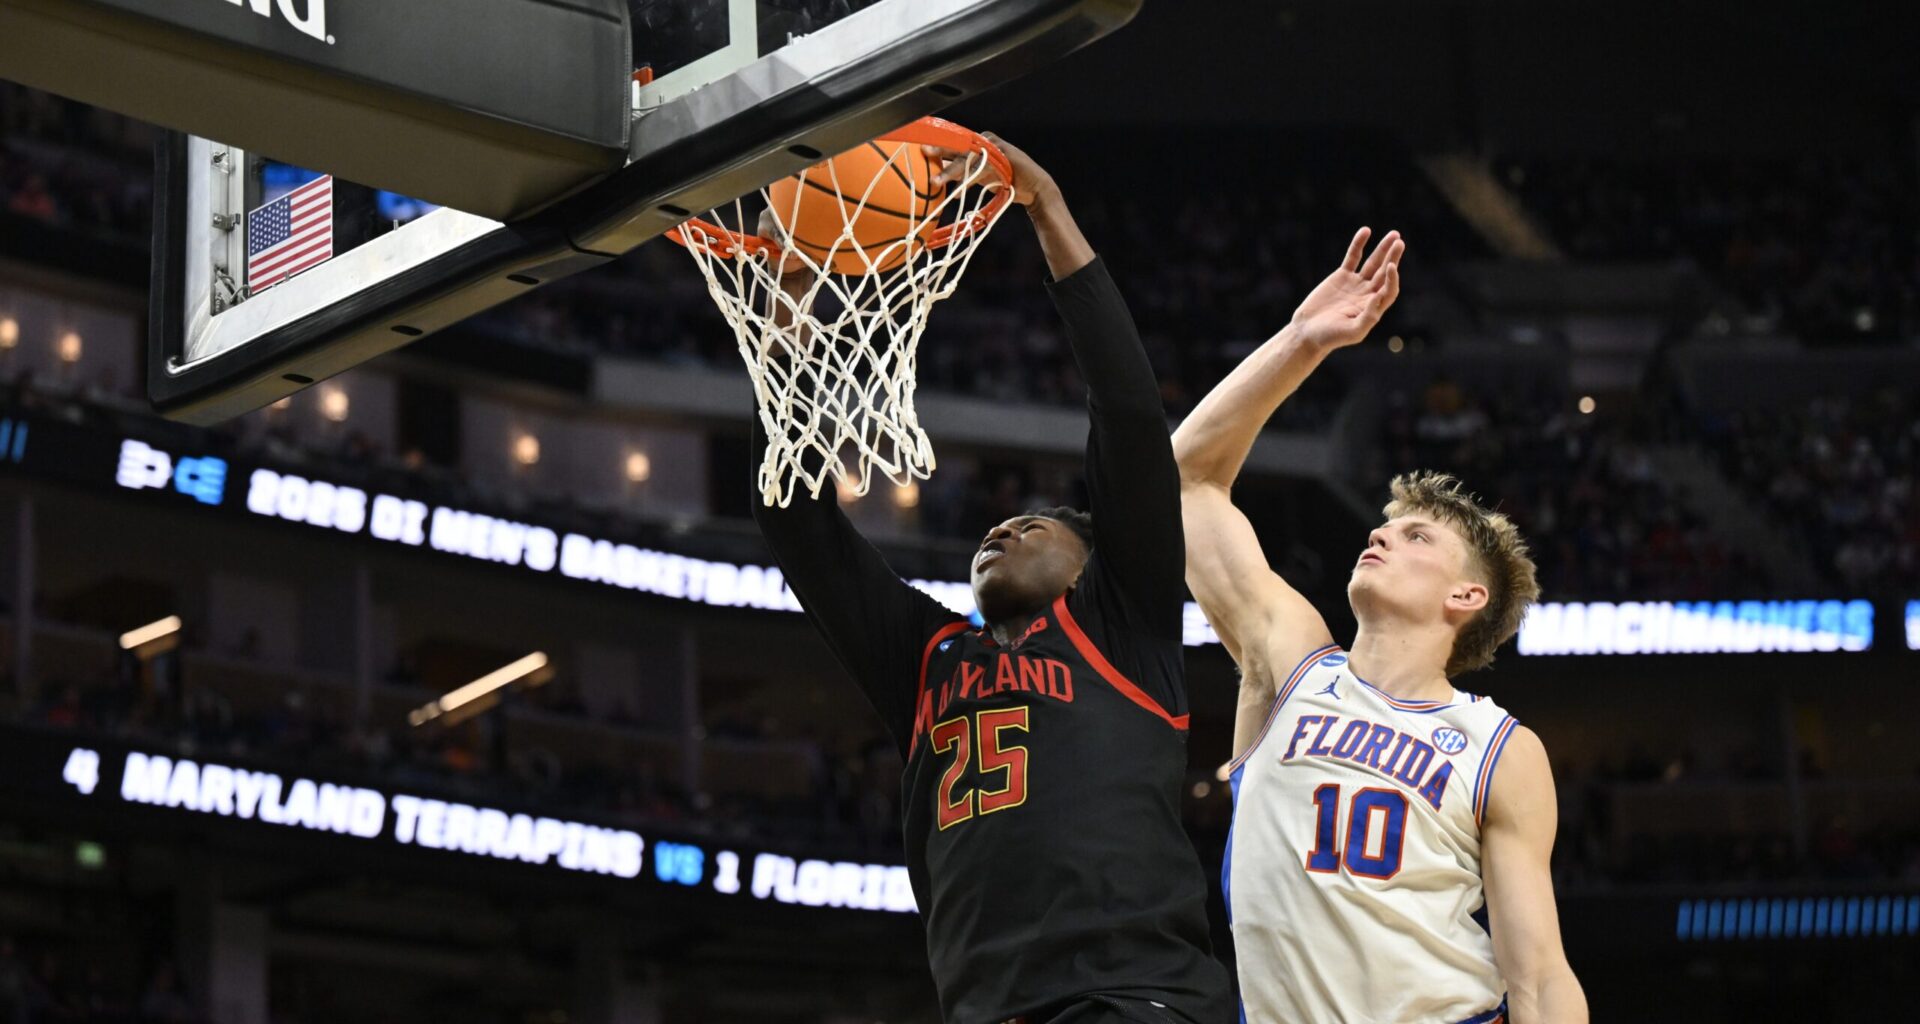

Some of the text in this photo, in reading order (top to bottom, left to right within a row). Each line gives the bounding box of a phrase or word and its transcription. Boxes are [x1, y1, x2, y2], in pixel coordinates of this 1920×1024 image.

[247, 468, 368, 533] 2025
[430, 506, 558, 571] MEN'S
[931, 706, 1030, 831] 25
[1280, 715, 1454, 813] FLORIDA
[1433, 727, 1468, 753] SEC
[63, 748, 919, 912] 4 MARYLAND TERRAPINS VS 1 FLORID
[1305, 783, 1410, 881] 10
